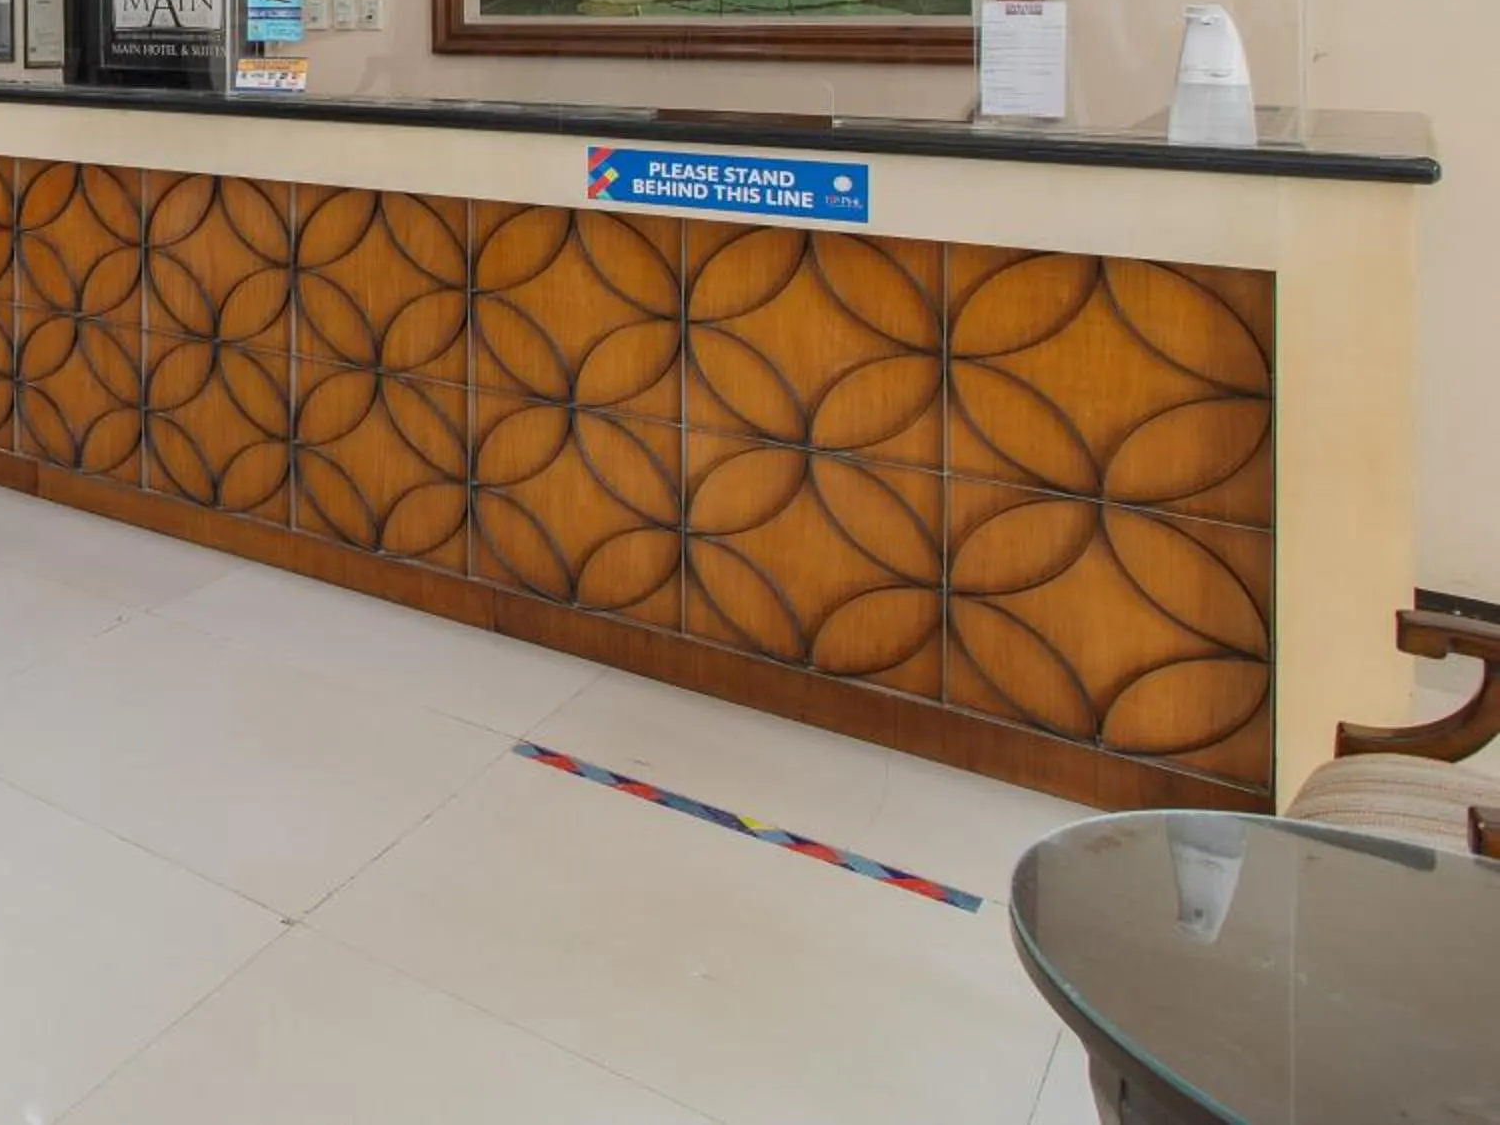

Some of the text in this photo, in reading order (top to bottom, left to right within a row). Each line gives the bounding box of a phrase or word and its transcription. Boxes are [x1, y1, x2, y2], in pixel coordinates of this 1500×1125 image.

[111, 43, 141, 55] MAIN
[143, 43, 177, 56] HOTEL
[649, 162, 795, 187] PLEASE STAND
[632, 178, 709, 200] BEHIND
[713, 184, 762, 204] THIS
[764, 189, 815, 209] LINE
